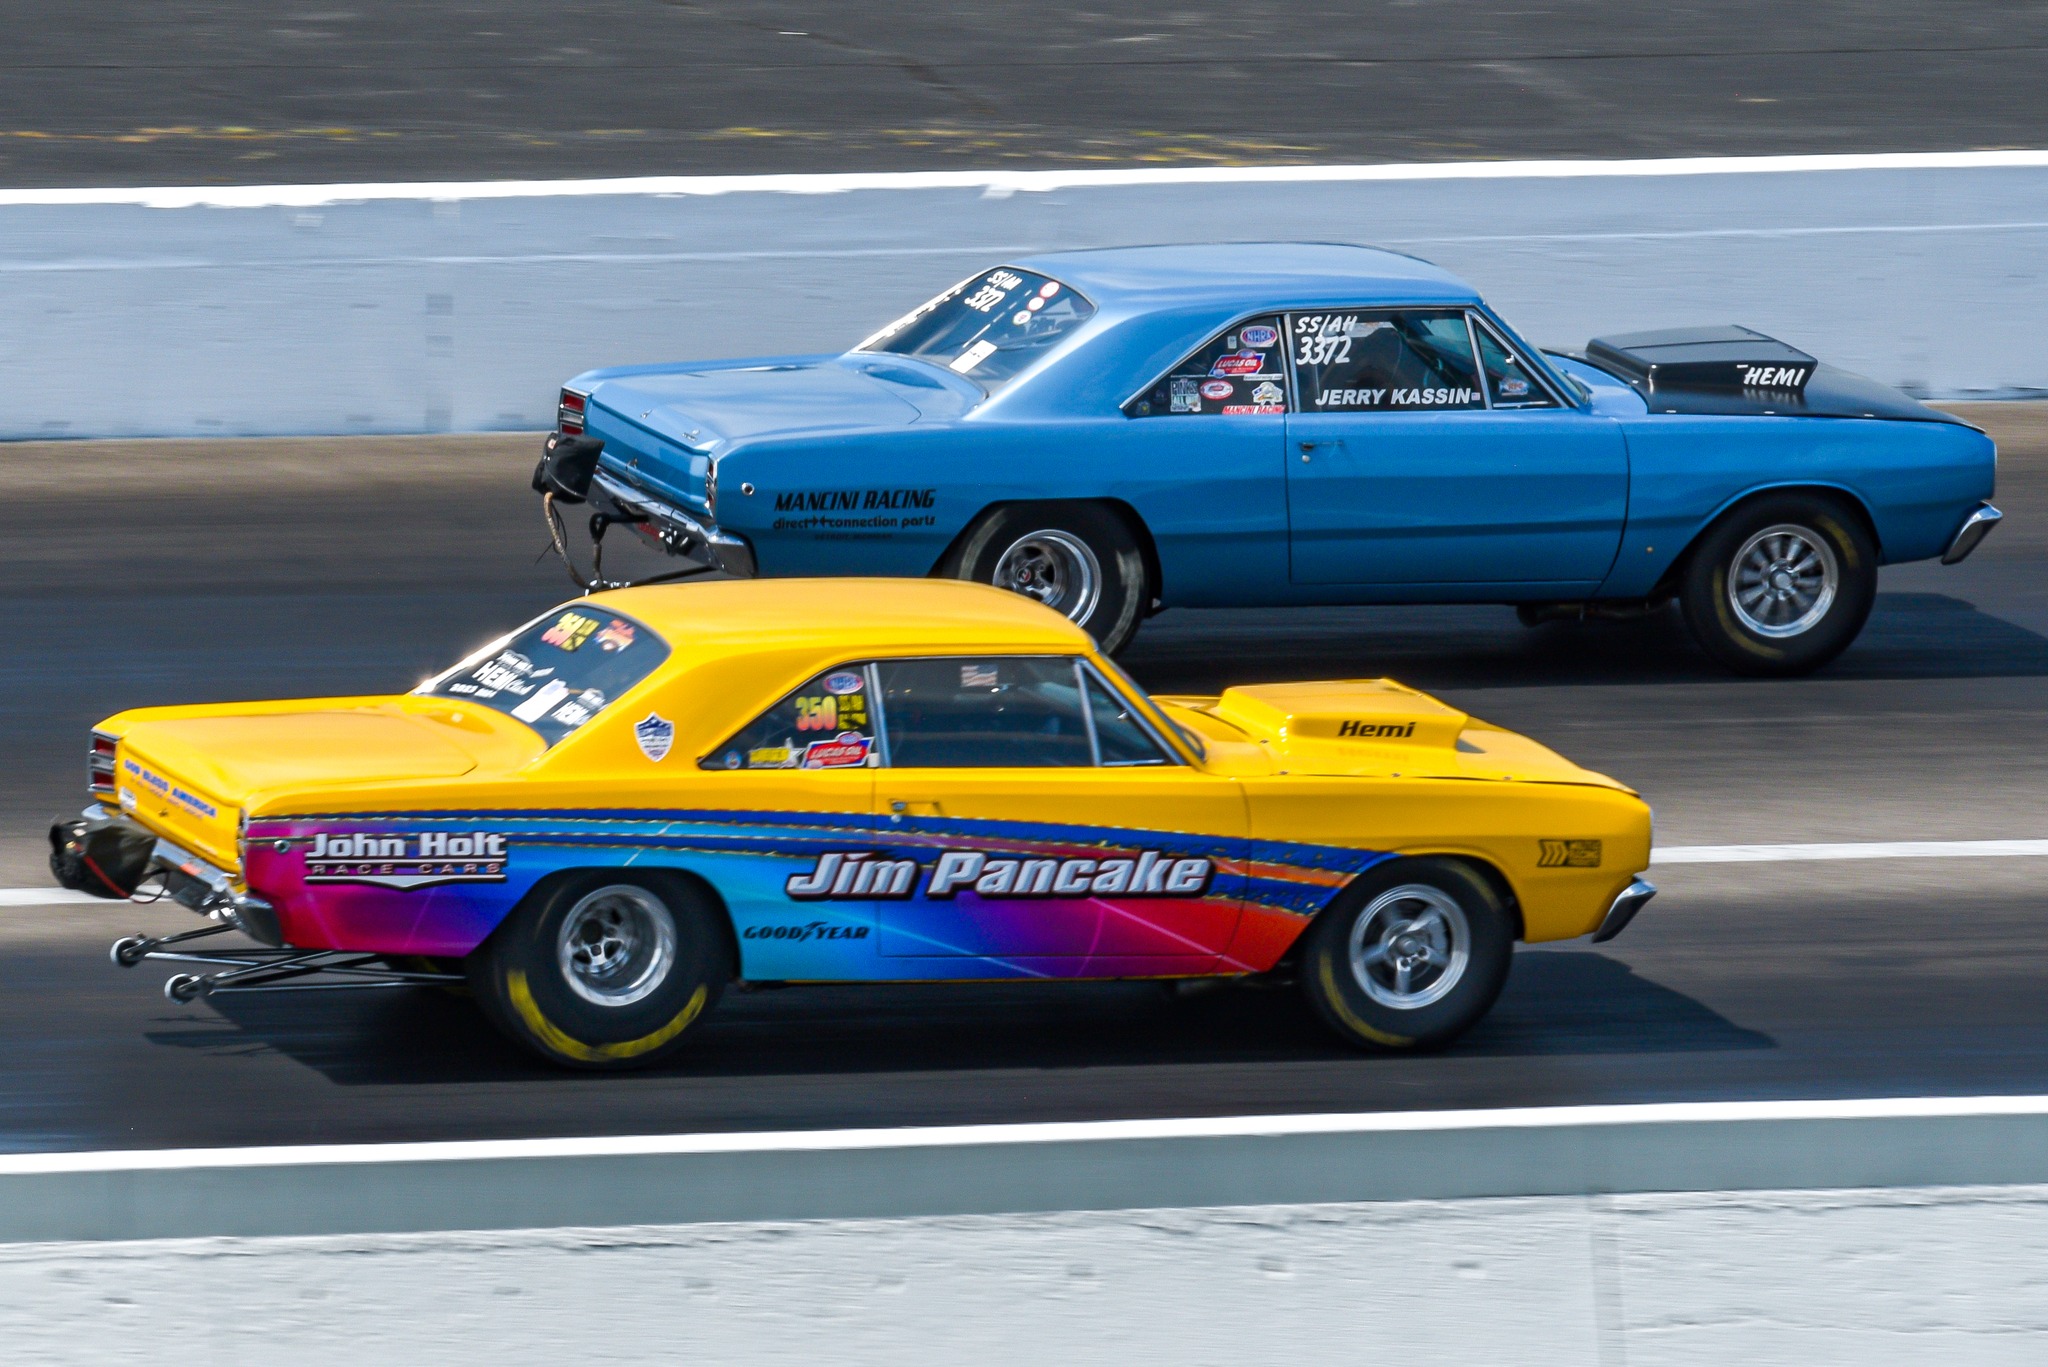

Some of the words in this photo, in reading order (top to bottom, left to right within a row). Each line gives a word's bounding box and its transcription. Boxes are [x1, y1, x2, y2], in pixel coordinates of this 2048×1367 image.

[1246, 330, 1272, 342] NHRA
[1295, 314, 1358, 337] SS/AH
[1296, 336, 1352, 366] 3372
[1217, 359, 1245, 368] LUCAS
[1245, 358, 1258, 367] OIL
[1743, 366, 1806, 387] HEMI
[1315, 388, 1387, 406] JERRY
[1390, 387, 1472, 405] KASSIN
[774, 491, 860, 511] MANCINI
[863, 488, 936, 509] RACING
[901, 515, 936, 529] parts
[795, 696, 838, 732] 350
[1337, 720, 1417, 738] Hemi
[811, 747, 845, 760] LUCAS
[845, 745, 863, 756] OIL
[172, 787, 217, 818] AMERICA
[304, 832, 406, 857] John
[419, 831, 507, 857] Holt
[311, 863, 395, 874] RACE
[418, 863, 500, 874] CARS
[788, 851, 922, 900] Jim
[927, 850, 1214, 900] Pancake
[743, 921, 870, 942] GOODYEAR
